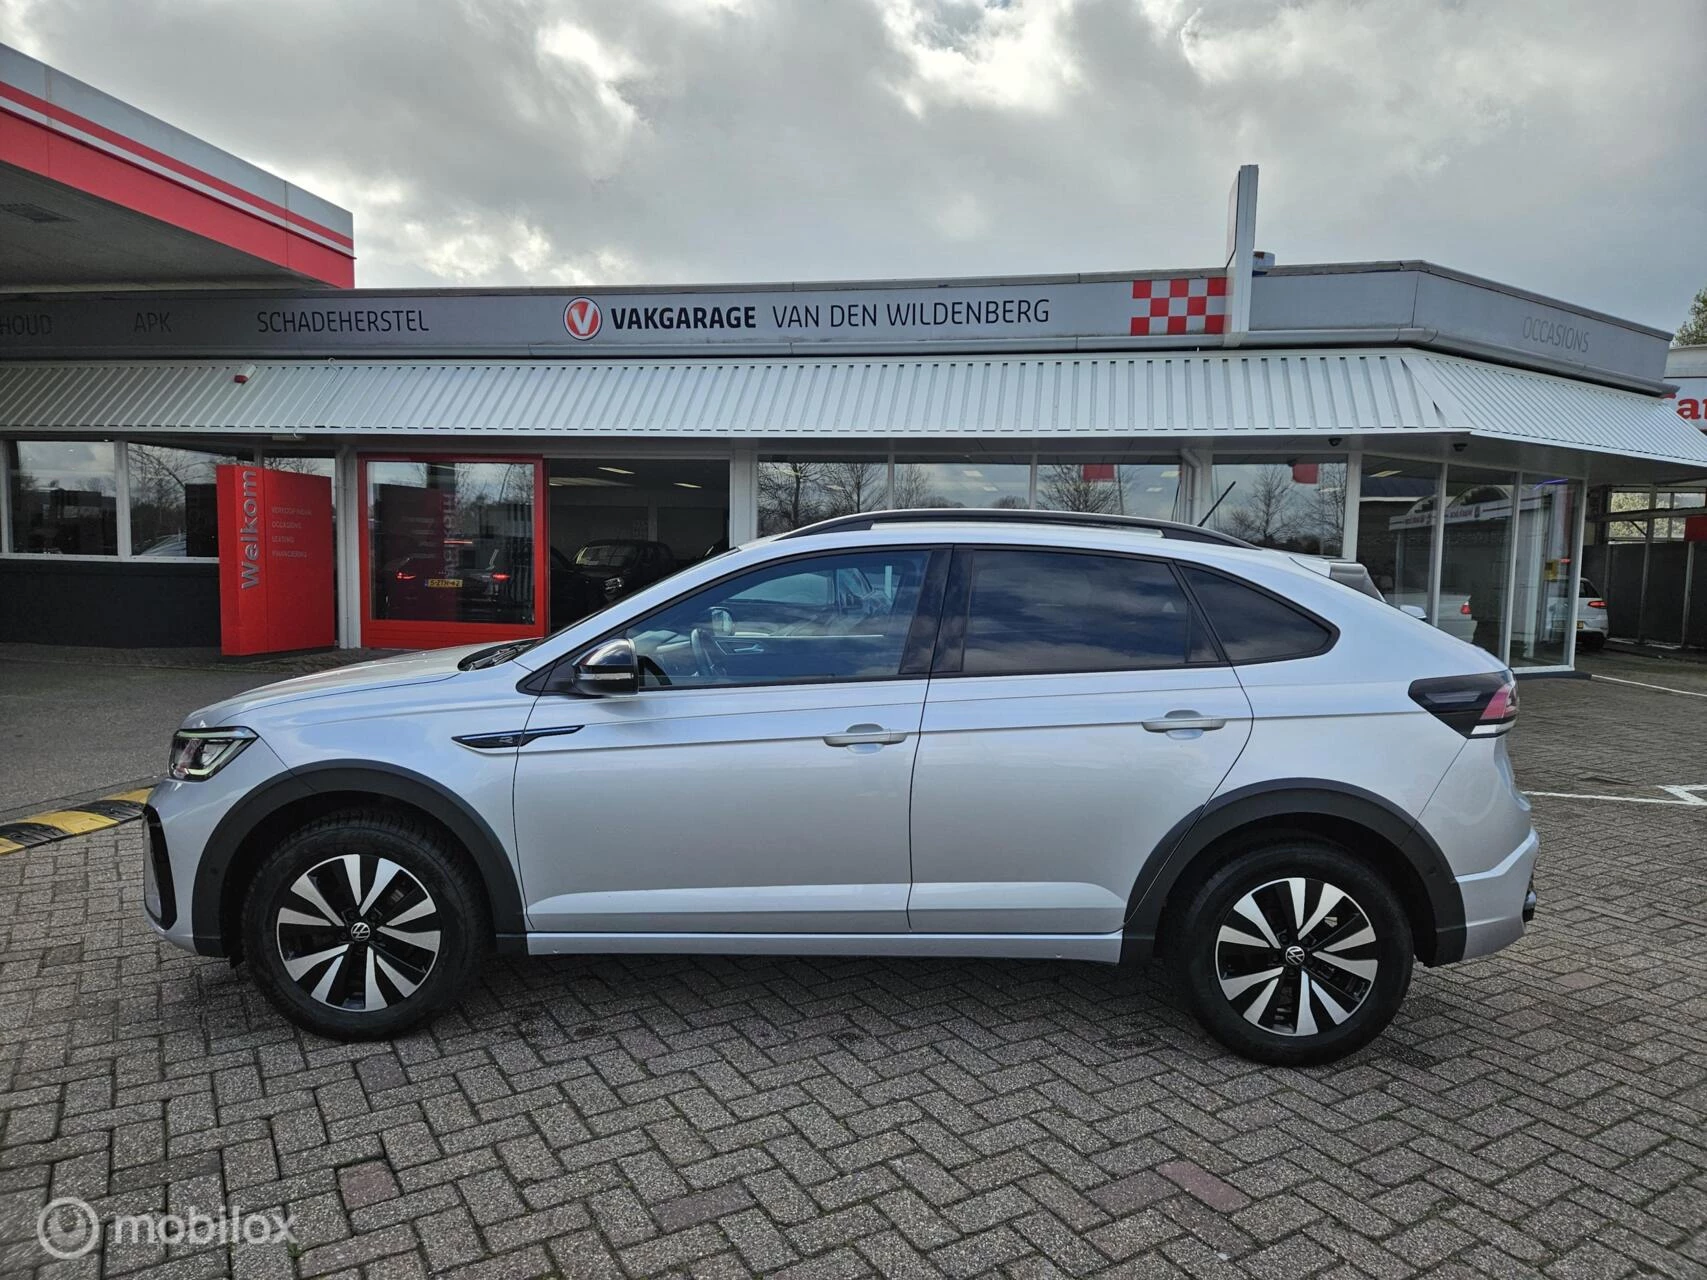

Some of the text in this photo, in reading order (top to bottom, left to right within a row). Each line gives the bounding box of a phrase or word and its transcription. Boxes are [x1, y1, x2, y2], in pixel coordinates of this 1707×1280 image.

[134, 311, 172, 333] APK
[257, 309, 430, 333] SCHADEHERSTEL
[610, 299, 1050, 330] VAKGARAGE VAN DEN WILDENBERG
[1522, 315, 1590, 353] OCCASIONS
[240, 470, 260, 589] Welkom
